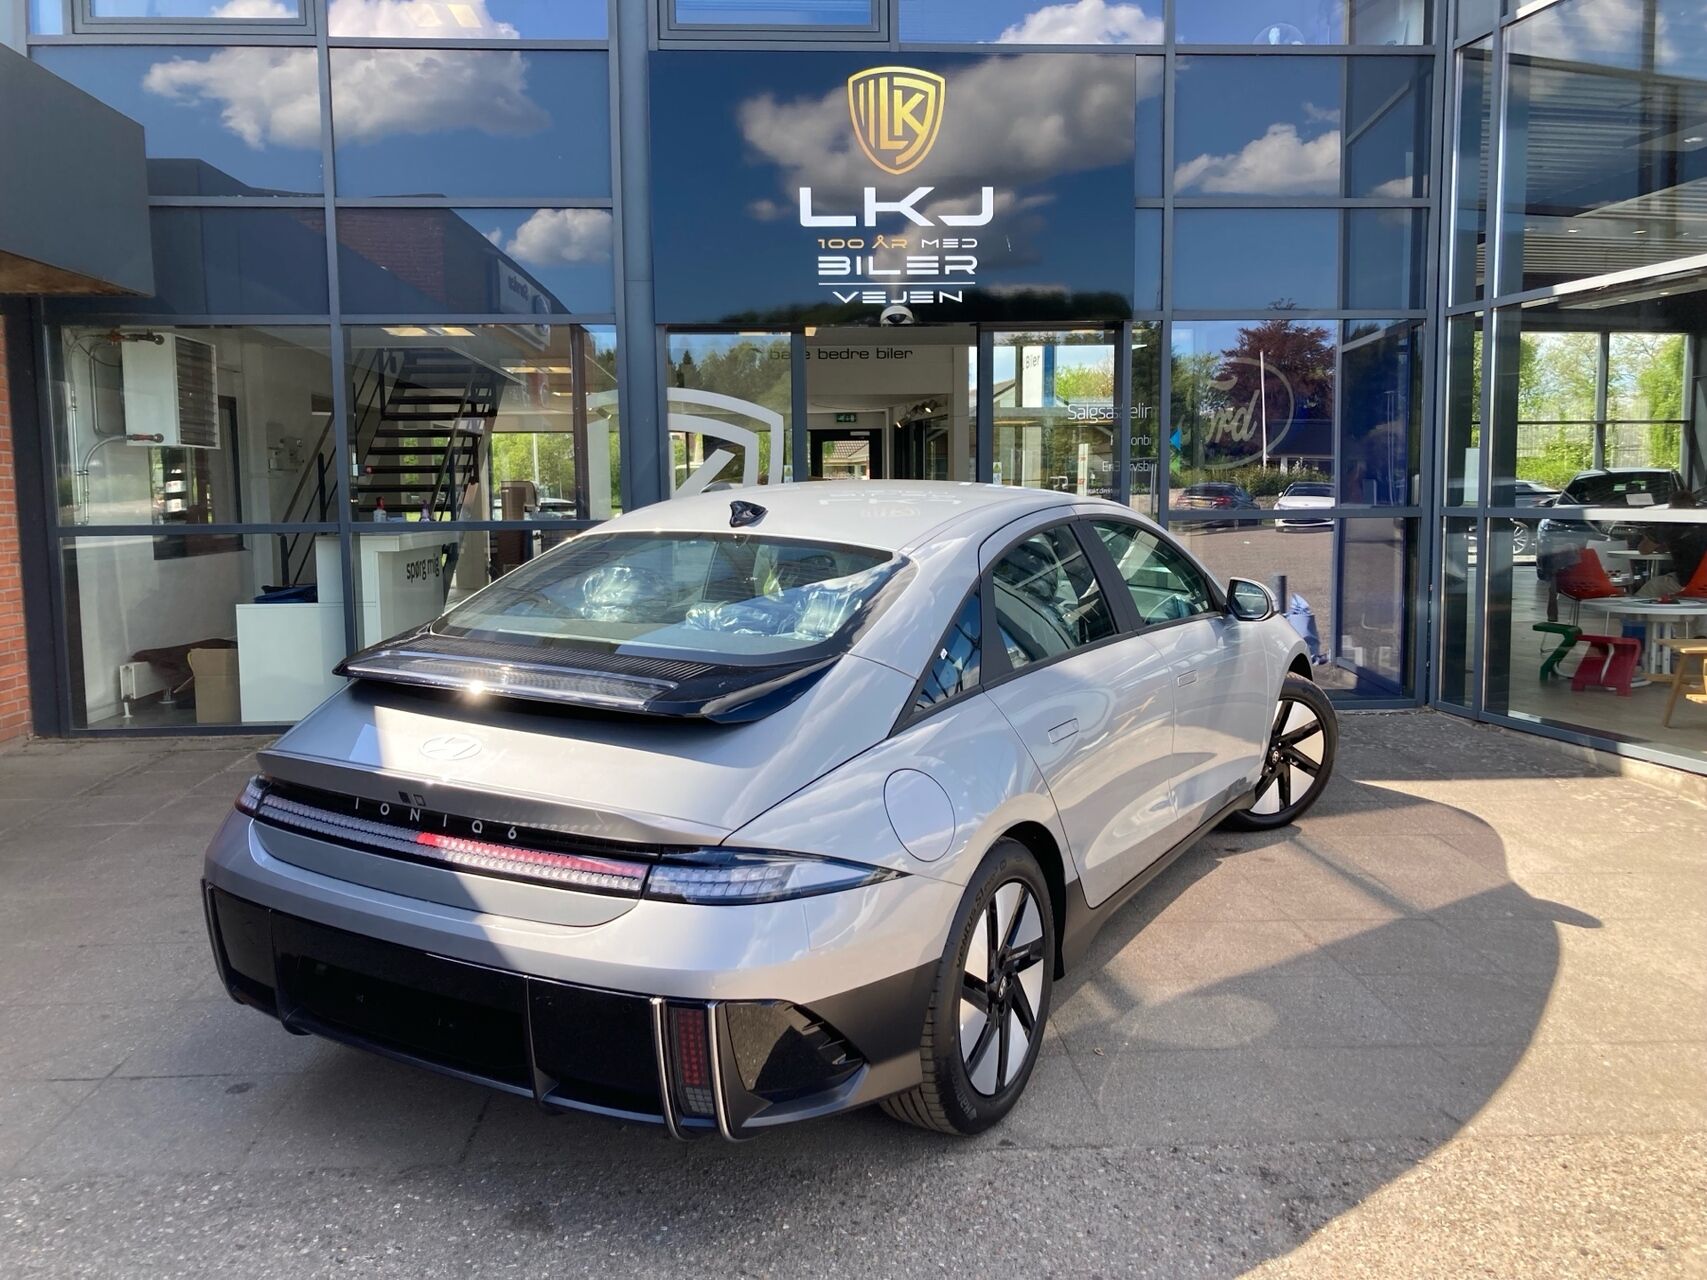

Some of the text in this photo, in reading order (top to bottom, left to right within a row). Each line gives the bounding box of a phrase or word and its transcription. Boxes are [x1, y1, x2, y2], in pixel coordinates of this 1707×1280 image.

[799, 186, 994, 227] LKJ
[818, 234, 978, 249] 100 ÅR MED
[817, 255, 978, 276] BILER
[832, 290, 963, 304] VEJEN
[817, 347, 870, 360] bedre
[876, 347, 913, 360] biler
[406, 552, 440, 584] spørg mig
[355, 797, 484, 834] IONIQ
